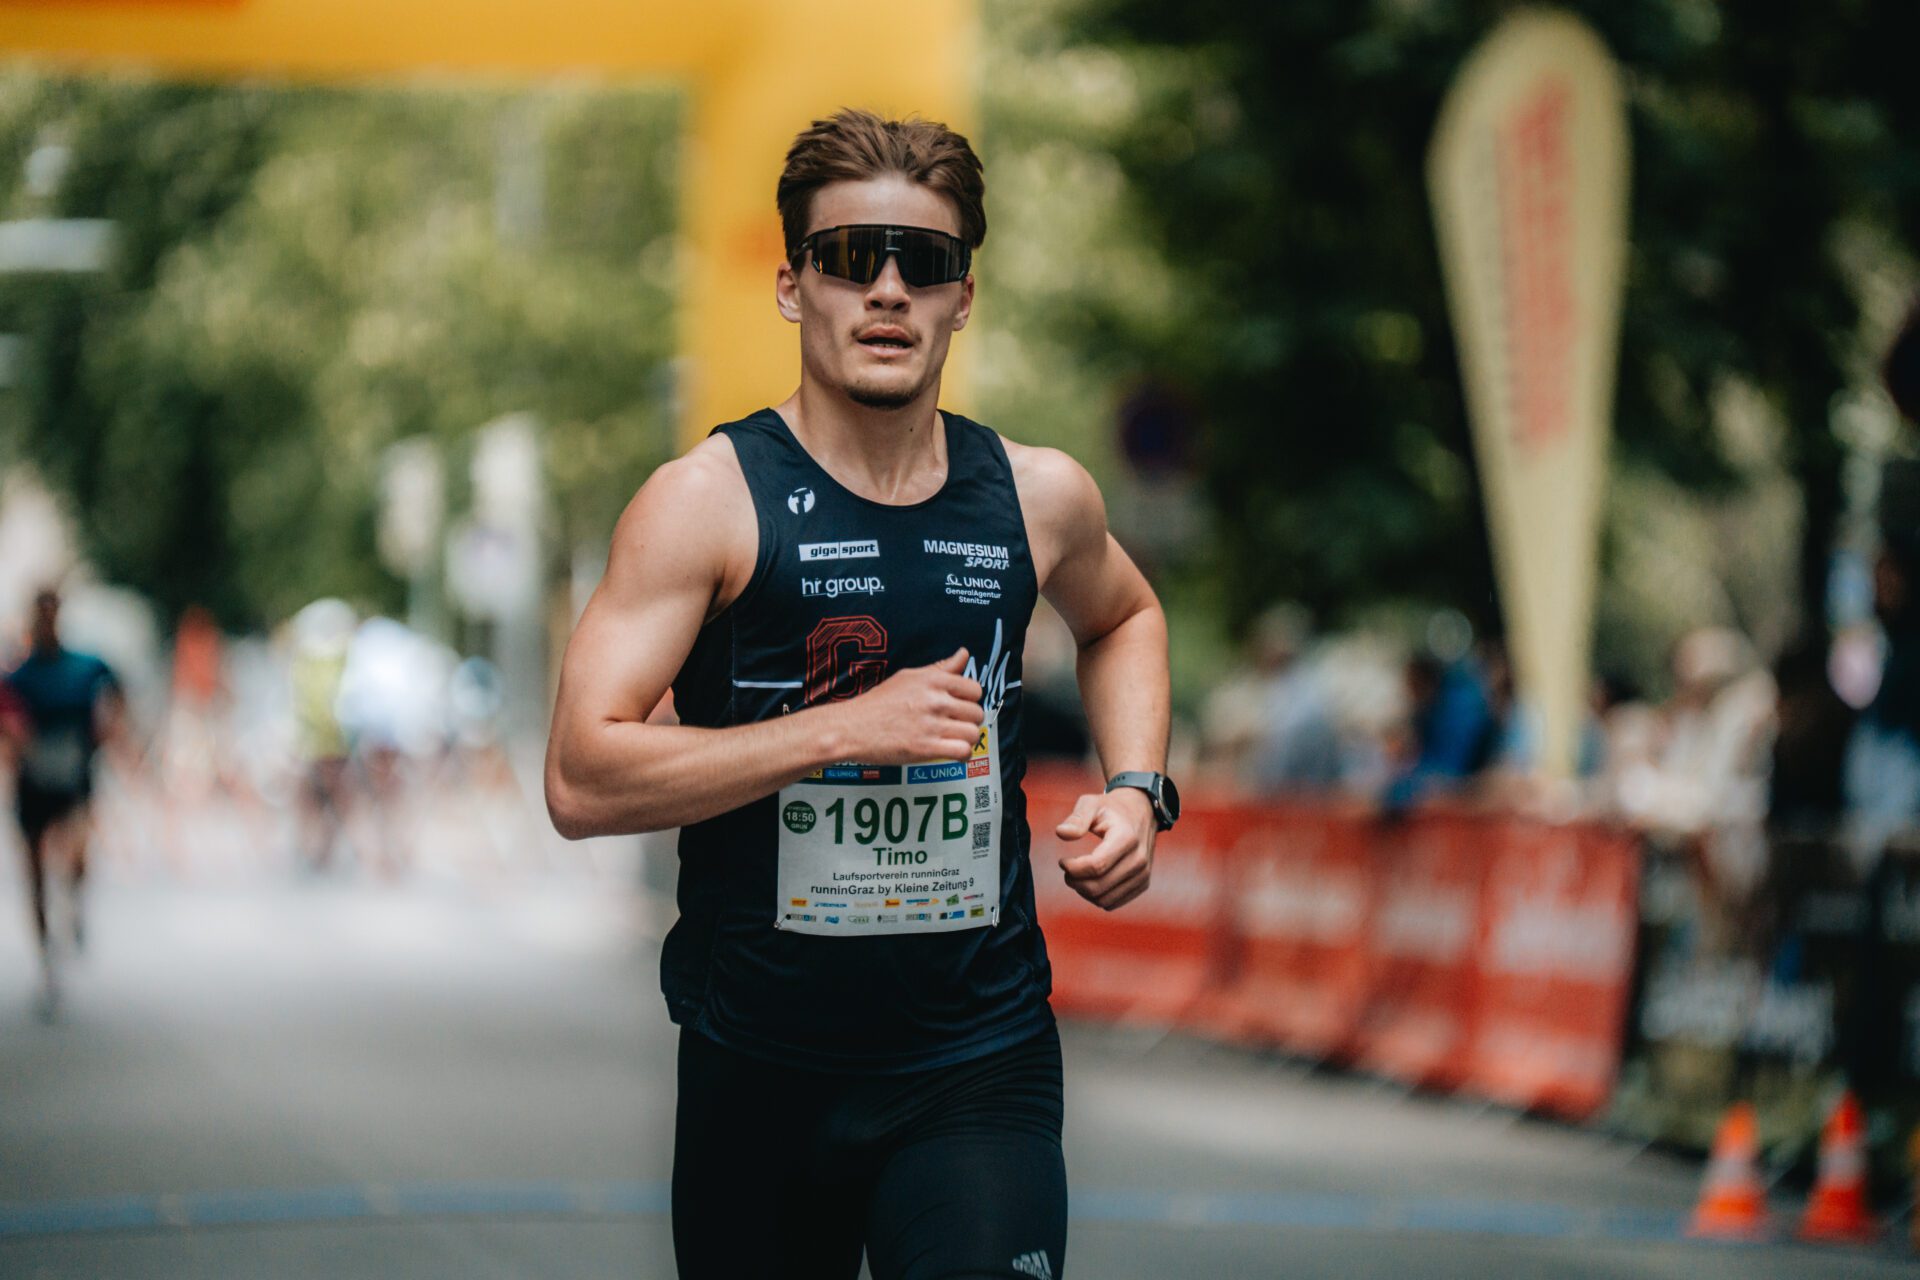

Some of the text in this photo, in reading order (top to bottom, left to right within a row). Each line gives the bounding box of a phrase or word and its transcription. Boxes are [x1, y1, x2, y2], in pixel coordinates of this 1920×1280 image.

[811, 544, 875, 557] giga sport
[923, 540, 1008, 559] MAGNESIUM
[965, 557, 1009, 570] SPORT
[802, 577, 884, 598] hr group.
[963, 577, 1000, 590] UNIQA
[945, 588, 1001, 599] GeneralAgentur
[959, 596, 990, 605] Stenitzer
[968, 759, 989, 768] KLEINE
[930, 767, 964, 779] UNIQA
[785, 811, 815, 823] 18:50
[825, 792, 969, 845] 1907B
[872, 847, 928, 866] Timo
[833, 868, 960, 882] Laufsportverein runninGraz
[811, 884, 874, 895] runninGraz
[878, 884, 891, 896] by
[894, 883, 929, 893] Kleine
[932, 880, 967, 891] Zeitung
